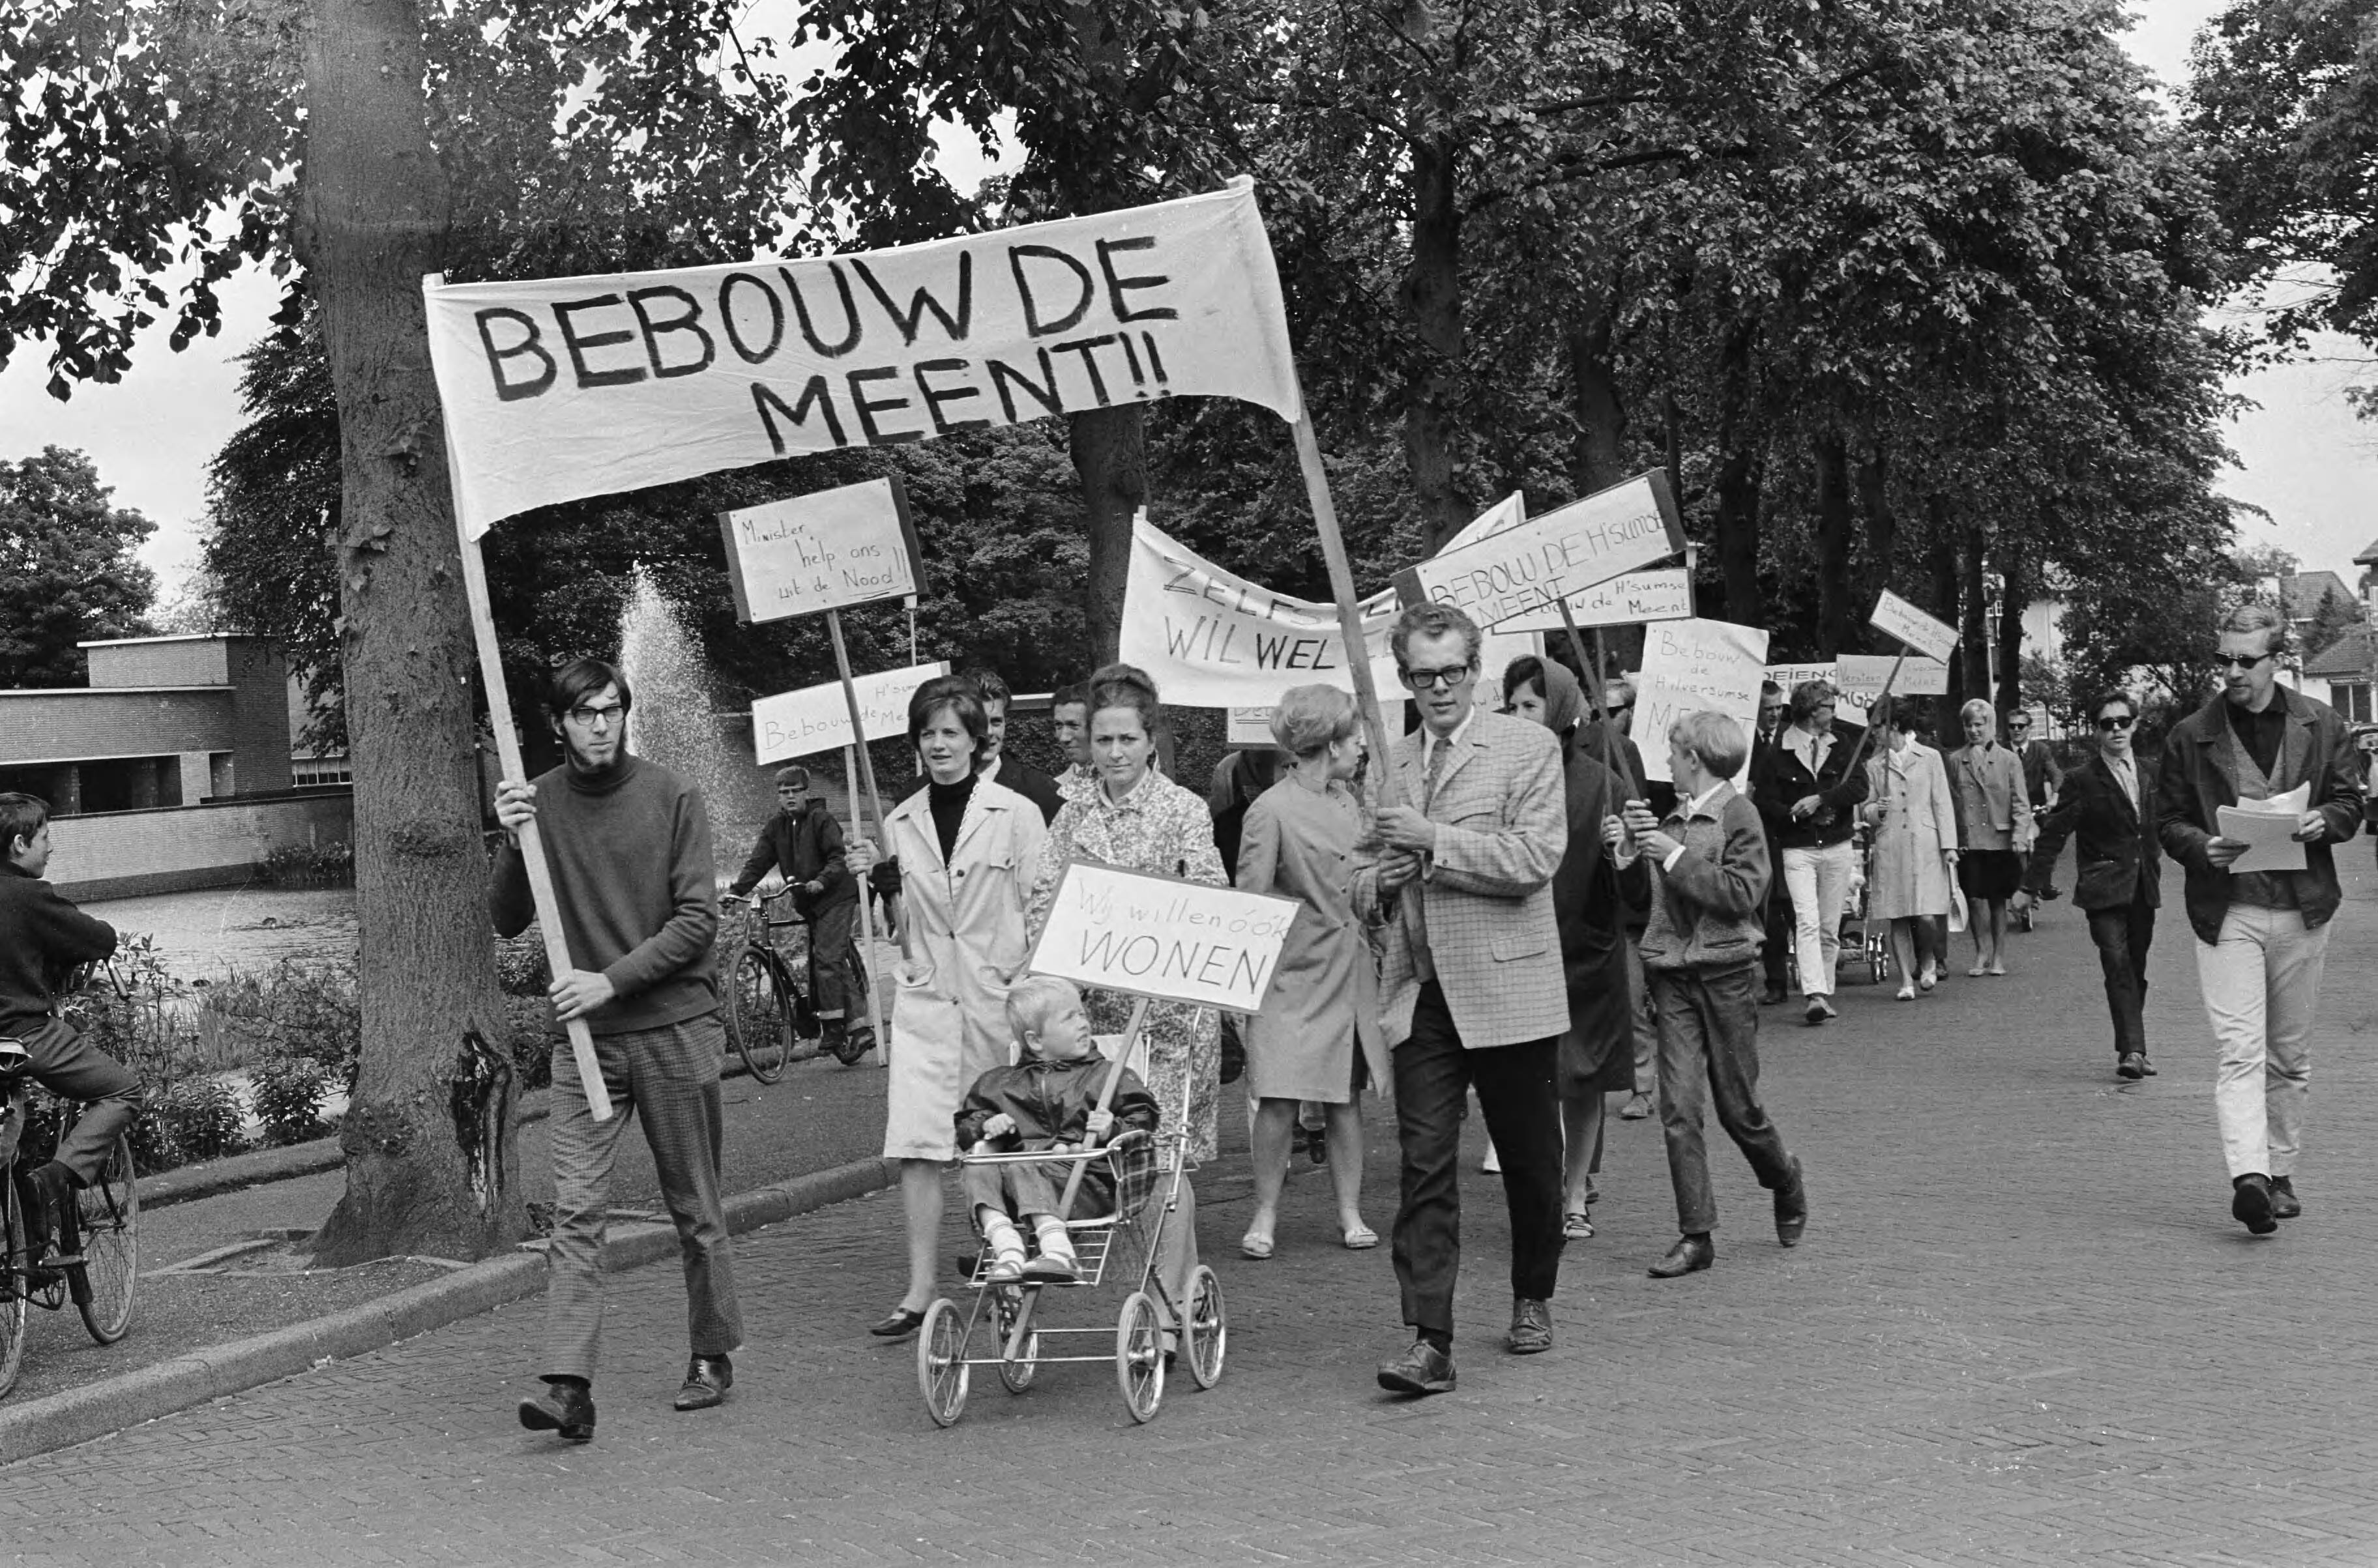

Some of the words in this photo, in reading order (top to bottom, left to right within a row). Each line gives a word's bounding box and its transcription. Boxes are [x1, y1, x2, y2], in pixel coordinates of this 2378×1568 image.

[474, 250, 971, 402] BEBOUW
[1008, 236, 1179, 339] DE
[749, 330, 1171, 454] MEENT!!
[742, 519, 806, 545] Minister
[795, 538, 836, 571] help
[850, 544, 881, 559] ons
[1542, 532, 1589, 574] DE
[778, 578, 804, 600] uit
[814, 575, 832, 592] de
[1476, 575, 1566, 626] MEENT
[1592, 592, 1613, 609] de
[1628, 597, 1690, 615] Meent
[1615, 580, 1688, 594] H'sumse
[1256, 632, 1336, 671] WEL
[1661, 630, 1740, 664] Bebouw
[1690, 663, 1709, 675] de
[1655, 673, 1750, 701] Hilversumse
[765, 713, 853, 751] Bebouw
[1130, 897, 1222, 929] willen
[1081, 929, 1267, 995] WONEN
